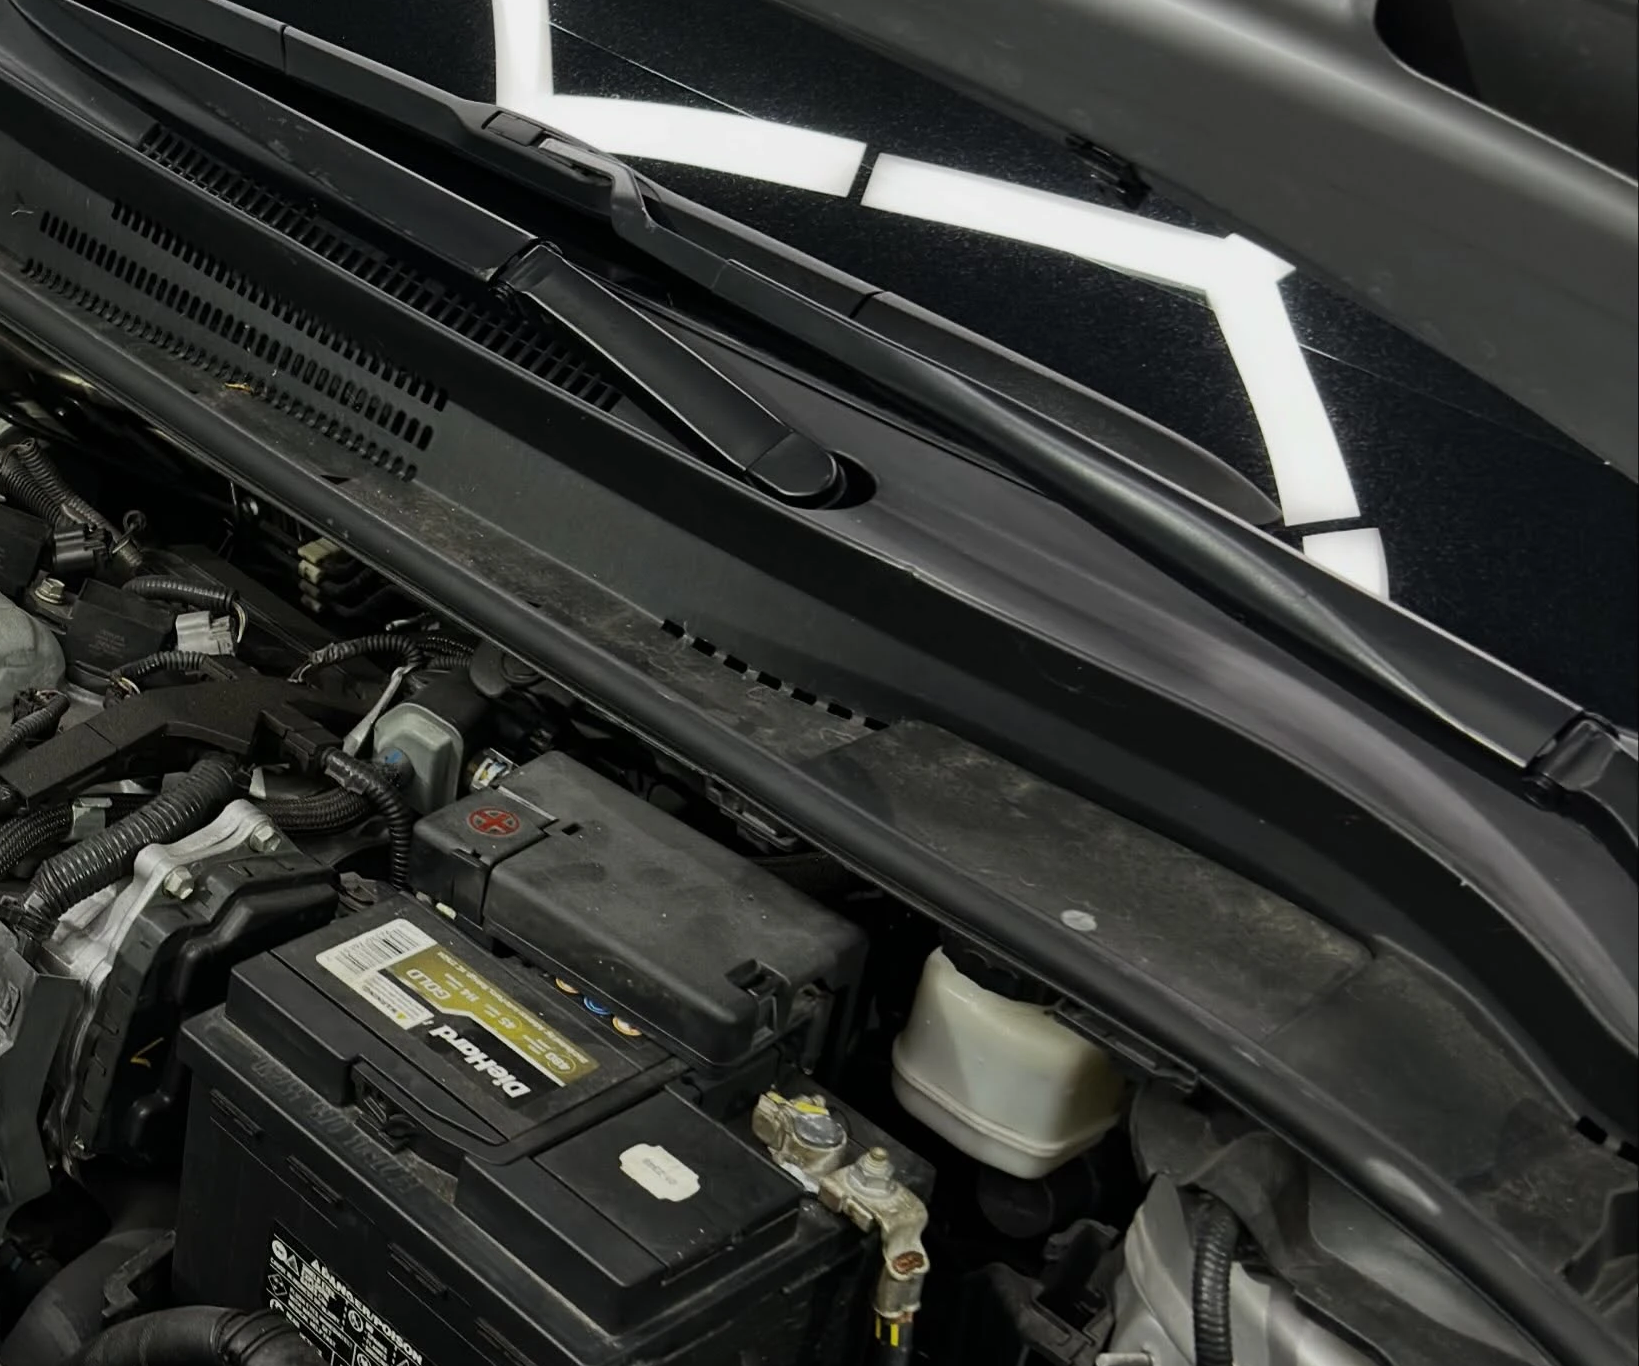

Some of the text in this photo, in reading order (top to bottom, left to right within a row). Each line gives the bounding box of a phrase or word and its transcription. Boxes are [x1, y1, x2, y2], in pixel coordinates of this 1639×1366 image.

[405, 968, 452, 1000] GOLD
[428, 1025, 532, 1099] DieHard
[320, 1265, 424, 1366] DANGER/POISON
